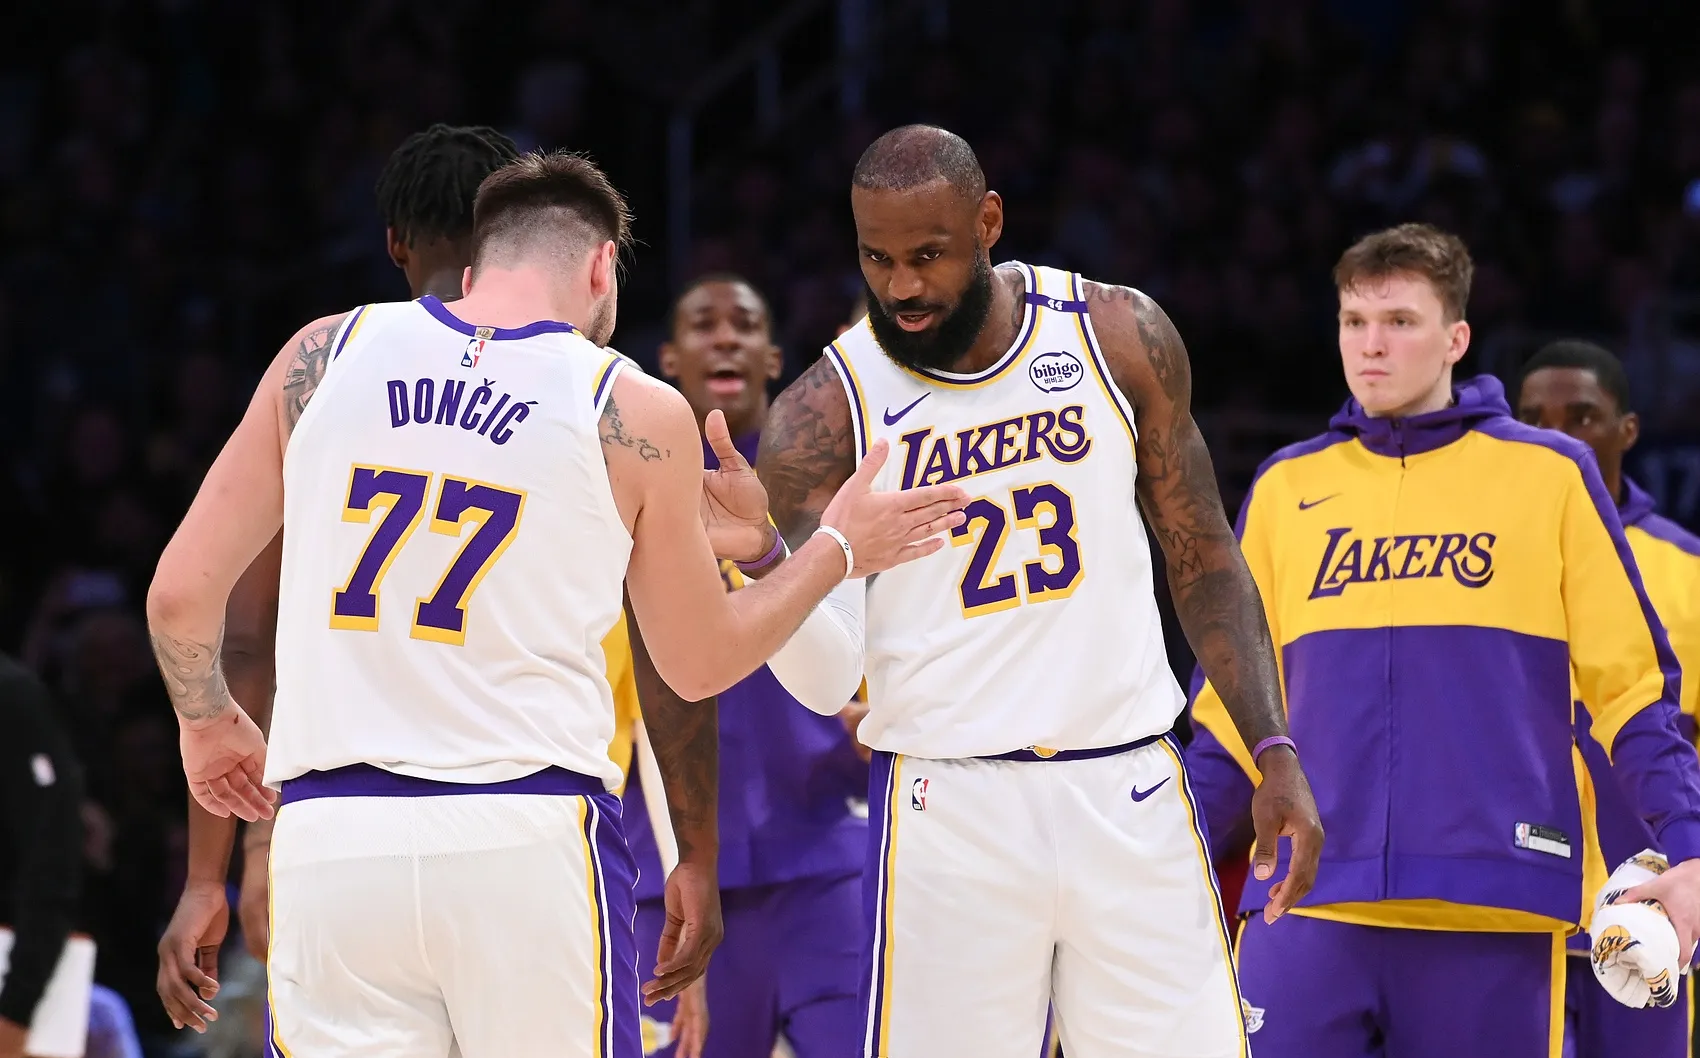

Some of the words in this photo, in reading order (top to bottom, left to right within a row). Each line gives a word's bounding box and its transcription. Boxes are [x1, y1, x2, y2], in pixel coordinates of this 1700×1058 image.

[1047, 299, 1063, 310] 44
[1033, 362, 1079, 378] bibigo
[1044, 376, 1064, 384] 비비고
[387, 377, 538, 445] DONČIĆ
[899, 405, 1093, 490] LAKERS
[329, 463, 527, 646] 77
[946, 480, 1085, 619] 23
[1307, 527, 1496, 601] LAKERS
